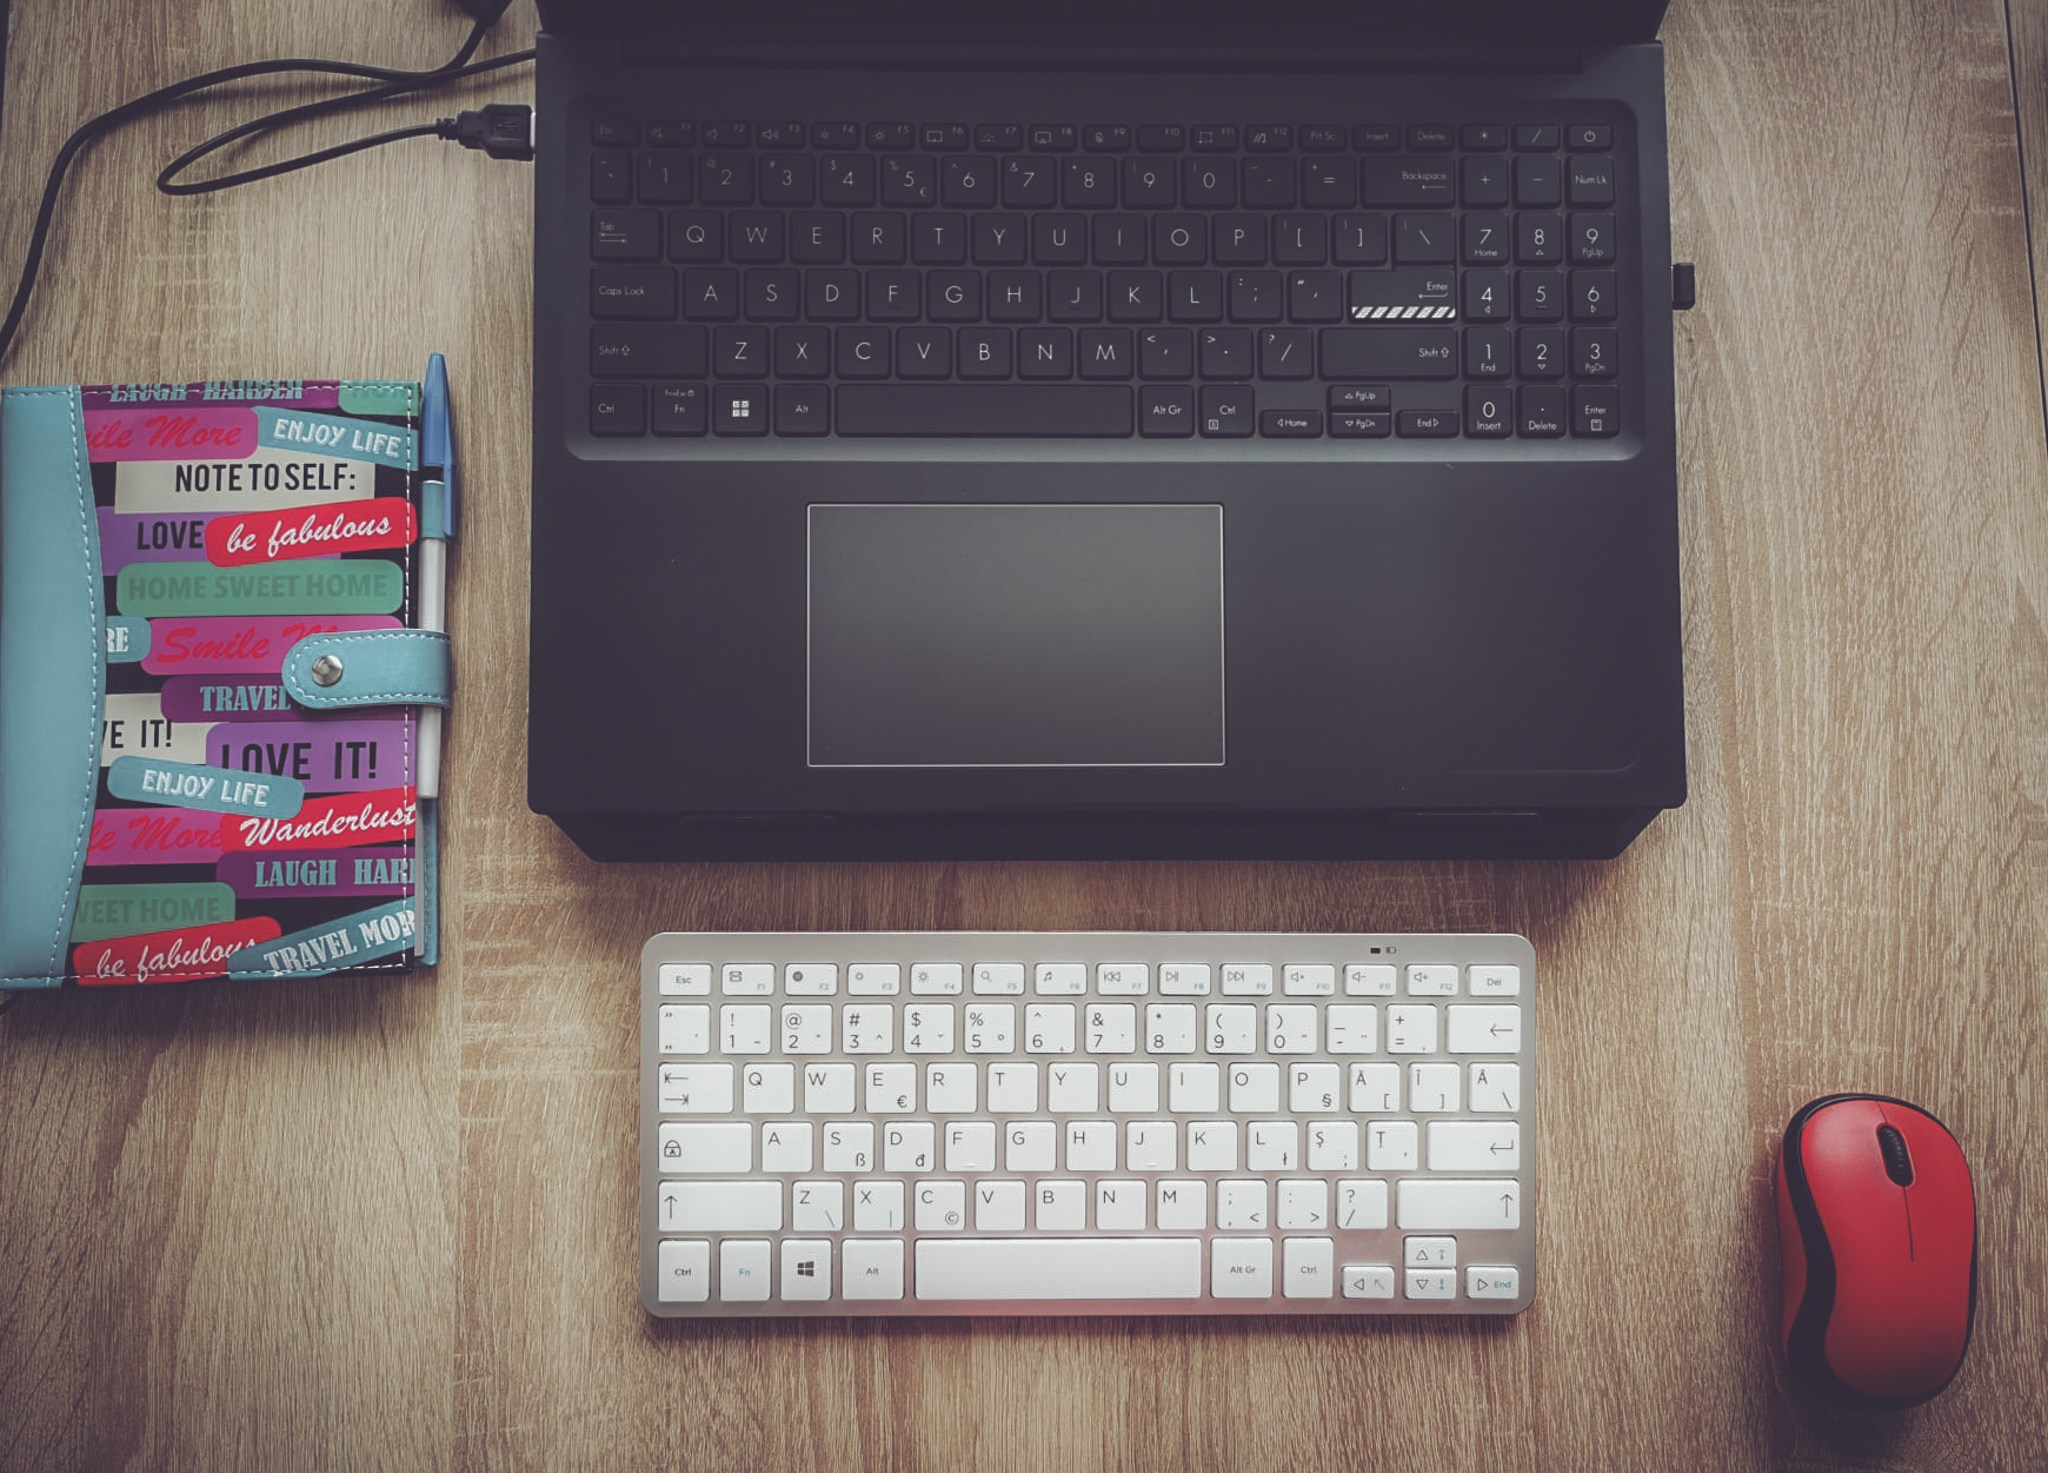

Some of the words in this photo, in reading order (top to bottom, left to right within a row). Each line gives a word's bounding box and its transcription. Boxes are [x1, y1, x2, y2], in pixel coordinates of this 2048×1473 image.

[1416, 131, 1446, 141] Delete
[720, 168, 732, 186] 2
[782, 169, 793, 186] 3
[842, 171, 854, 185] 4
[903, 170, 915, 188] 5
[962, 172, 975, 188] 6
[1023, 171, 1036, 188] 7
[1083, 172, 1095, 189] 8
[1143, 172, 1156, 188] 9
[1401, 170, 1447, 182] Backspace
[1575, 174, 1596, 185] Num
[1596, 175, 1607, 185] Lk
[600, 221, 615, 231] Tab
[686, 225, 705, 244] Q
[746, 226, 768, 244] W
[812, 226, 822, 245] E
[872, 226, 883, 244] R
[934, 227, 944, 245] T
[993, 228, 1006, 246] Y
[1052, 228, 1066, 247] U
[1170, 228, 1190, 247] O
[1234, 228, 1245, 246] P
[1480, 228, 1492, 245] 7
[1534, 228, 1545, 245] 8
[1585, 227, 1599, 244] 9
[1474, 249, 1498, 257] Home
[598, 285, 623, 297] Caps
[624, 285, 645, 296] Lock
[703, 284, 718, 302] A
[765, 283, 778, 303] S
[825, 284, 840, 303] D
[888, 284, 898, 303] F
[1426, 280, 1449, 292] Enter
[1480, 286, 1493, 302] 4
[1535, 285, 1547, 303] 5
[945, 285, 964, 304] G
[1007, 286, 1022, 303] H
[1070, 286, 1081, 304] J
[1128, 286, 1141, 304] K
[1190, 286, 1200, 304] L
[1587, 286, 1600, 303] 6
[598, 345, 619, 356] Shift
[734, 341, 748, 360] Z
[796, 342, 808, 360] X
[855, 341, 871, 360] C
[917, 342, 931, 360] V
[979, 342, 991, 361] B
[1038, 343, 1053, 361] N
[1095, 344, 1116, 361] M
[1418, 347, 1439, 358] Shift
[1536, 343, 1548, 360] 2
[1590, 342, 1601, 360] 3
[1480, 362, 1496, 372] End
[1355, 390, 1377, 402] PgUp
[598, 403, 615, 414] Ctrl
[674, 403, 685, 413] Fn
[795, 404, 809, 414] Alt
[1152, 405, 1167, 415] Alt
[1167, 404, 1182, 416] Gr
[1218, 404, 1236, 416] Ctrl
[1584, 404, 1607, 415] Enter
[1284, 418, 1308, 428] Home
[1416, 418, 1435, 428] End
[1476, 420, 1502, 431] Insert
[1528, 419, 1557, 431] Delete
[86, 419, 134, 449] ile
[145, 416, 242, 449] More
[273, 418, 348, 448] ENJOY
[352, 429, 401, 458] LIFE
[175, 464, 243, 492] NOTE
[247, 463, 279, 491] TO
[285, 463, 356, 490] SELF:
[136, 520, 205, 550] LOVE
[226, 523, 257, 553] be
[267, 513, 392, 558] fabulous
[129, 576, 206, 601] HOME
[214, 575, 299, 600] SWEET
[306, 574, 387, 598] HOME
[156, 627, 270, 663] Smile
[200, 686, 291, 712] TRAVEL
[141, 720, 172, 748] IT!
[334, 741, 377, 780] IT!
[142, 769, 214, 799] ENJOY
[221, 781, 271, 808] LIFE
[239, 802, 416, 847] Wanderlust
[255, 859, 337, 888] LAUGH
[141, 897, 221, 924] HOME
[96, 948, 126, 980] be
[137, 938, 256, 983] fabulou
[263, 928, 358, 977] TRAVEL
[675, 975, 692, 985] Esc
[1486, 977, 1502, 987] Del
[788, 1034, 799, 1049] 2
[849, 1034, 860, 1049] 3
[910, 1033, 922, 1048] 4
[971, 1033, 982, 1049] 5
[1032, 1033, 1044, 1049] 6
[1093, 1033, 1104, 1048] 7
[1153, 1034, 1165, 1049] 8
[1213, 1034, 1225, 1049] 9
[747, 1071, 763, 1087] Q
[807, 1072, 827, 1087] W
[872, 1071, 884, 1087] E
[932, 1071, 945, 1087] R
[994, 1071, 1006, 1087] T
[1054, 1071, 1068, 1087] Y
[1115, 1071, 1128, 1087] U
[1234, 1071, 1249, 1087] O
[1297, 1071, 1309, 1086] P
[767, 1131, 781, 1146] A
[830, 1131, 842, 1146] S
[890, 1131, 903, 1146] D
[952, 1131, 964, 1146] F
[1011, 1130, 1026, 1146] G
[1073, 1130, 1086, 1145] H
[1135, 1131, 1144, 1146] J
[1194, 1131, 1207, 1146] K
[1256, 1131, 1266, 1146] L
[799, 1189, 811, 1205] Z
[860, 1190, 872, 1204] X
[920, 1189, 934, 1205] C
[981, 1190, 995, 1205] V
[1042, 1189, 1055, 1205] B
[1103, 1190, 1116, 1204] N
[1162, 1189, 1177, 1204] M
[674, 1267, 692, 1277] Ctrl
[738, 1268, 752, 1278] Fn
[865, 1267, 879, 1276] Alt
[1229, 1265, 1243, 1274] Alt
[1244, 1265, 1256, 1275] Gr
[1300, 1265, 1317, 1275] Ctrl
[1493, 1280, 1512, 1290] End
